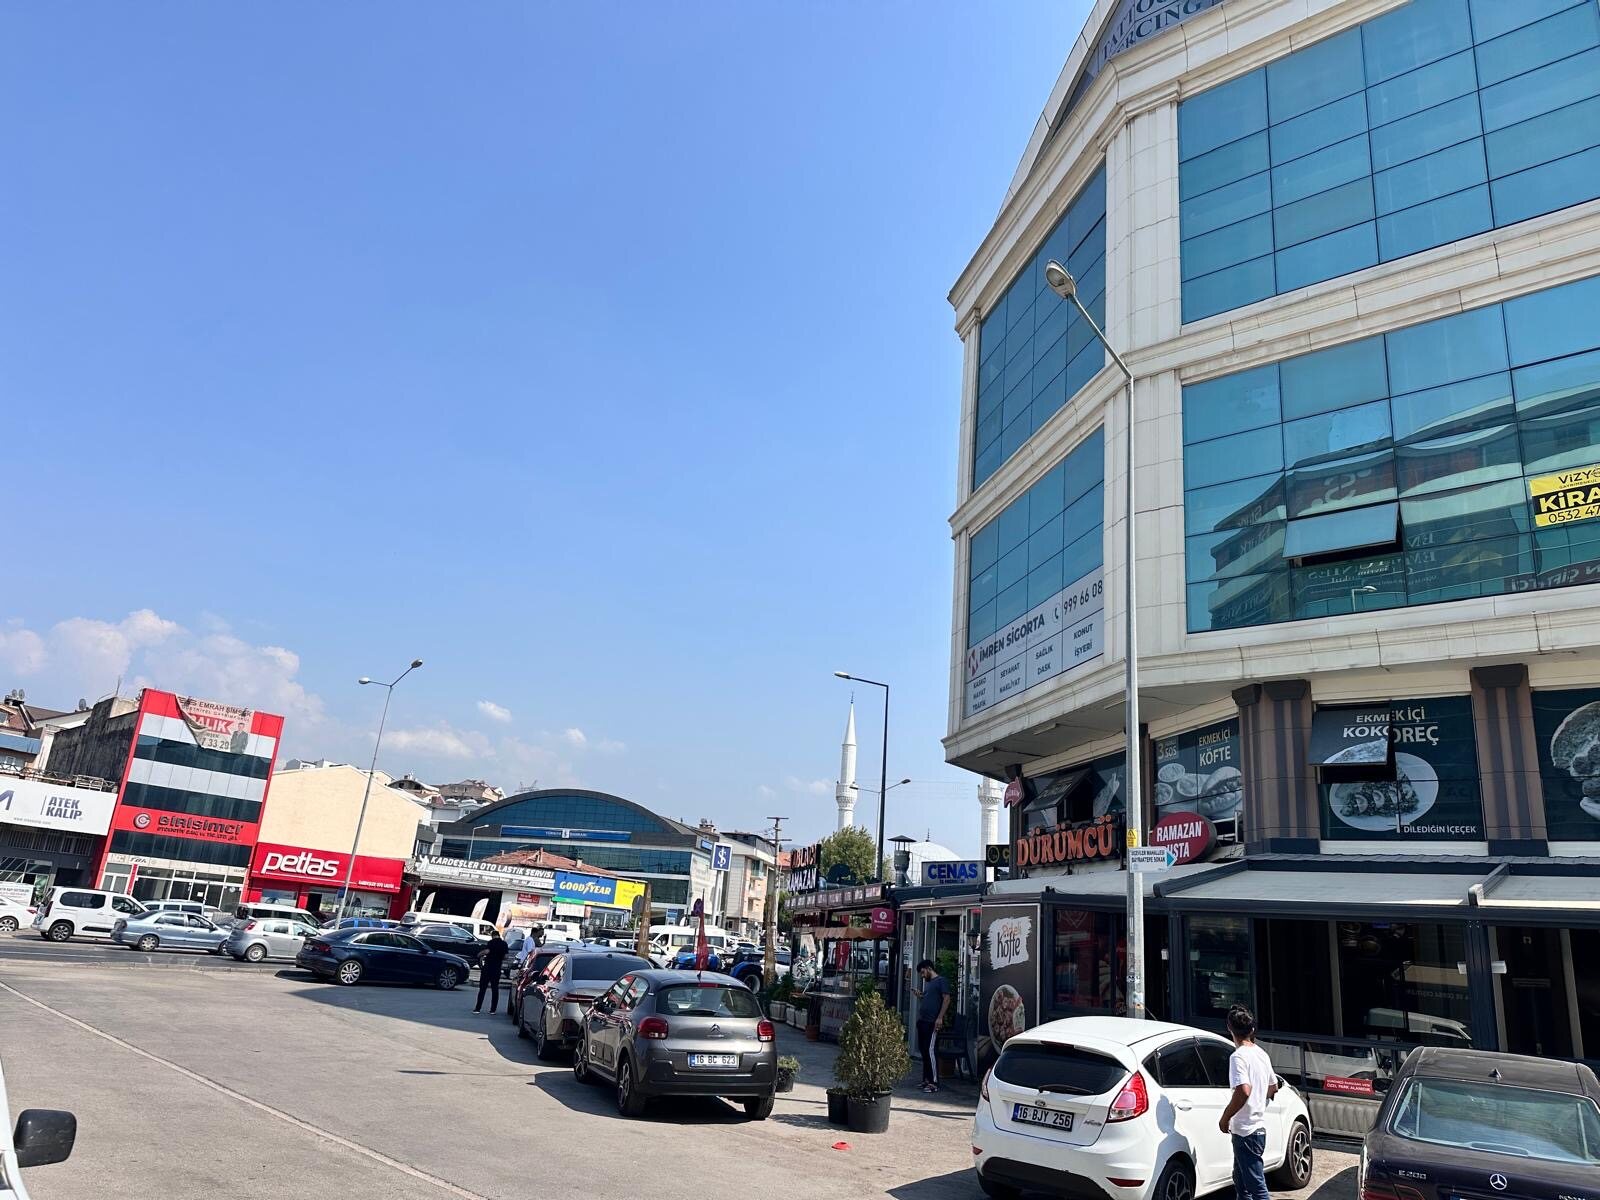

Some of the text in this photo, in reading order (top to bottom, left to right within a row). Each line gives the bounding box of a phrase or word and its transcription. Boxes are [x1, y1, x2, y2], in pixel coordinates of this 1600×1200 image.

[1102, 0, 1167, 59] TATTO
[1548, 508, 1581, 523] 0532
[979, 579, 1103, 662] İMREN SİGORTA 999 66 08
[1073, 623, 1093, 640] KONUT
[1037, 662, 1051, 675] DASK
[199, 701, 225, 713] EMRAH
[1407, 706, 1425, 723] İÇİ
[1199, 726, 1230, 746] EKMEK İÇİ
[1343, 725, 1439, 746] KOKOREÇ
[1157, 742, 1164, 760] 3
[1199, 745, 1231, 767] KÖFTE
[48, 796, 80, 809] ATEK
[45, 807, 82, 820] KALIP
[1156, 821, 1203, 842] RAMAZAN
[1403, 825, 1445, 833] DİLEDİĞİN
[1017, 815, 1113, 866] DÜRÜMCÜ
[261, 852, 340, 877] petlas
[431, 855, 479, 870] KARDEŞLER
[480, 862, 496, 871] OTO
[498, 865, 523, 875] LASTİK
[927, 863, 978, 880] CENAS
[696, 1056, 736, 1064] 16 BC 623
[1019, 1106, 1028, 1118] 16
[1032, 1109, 1049, 1122] BJY
[1053, 1113, 1071, 1127] 256
